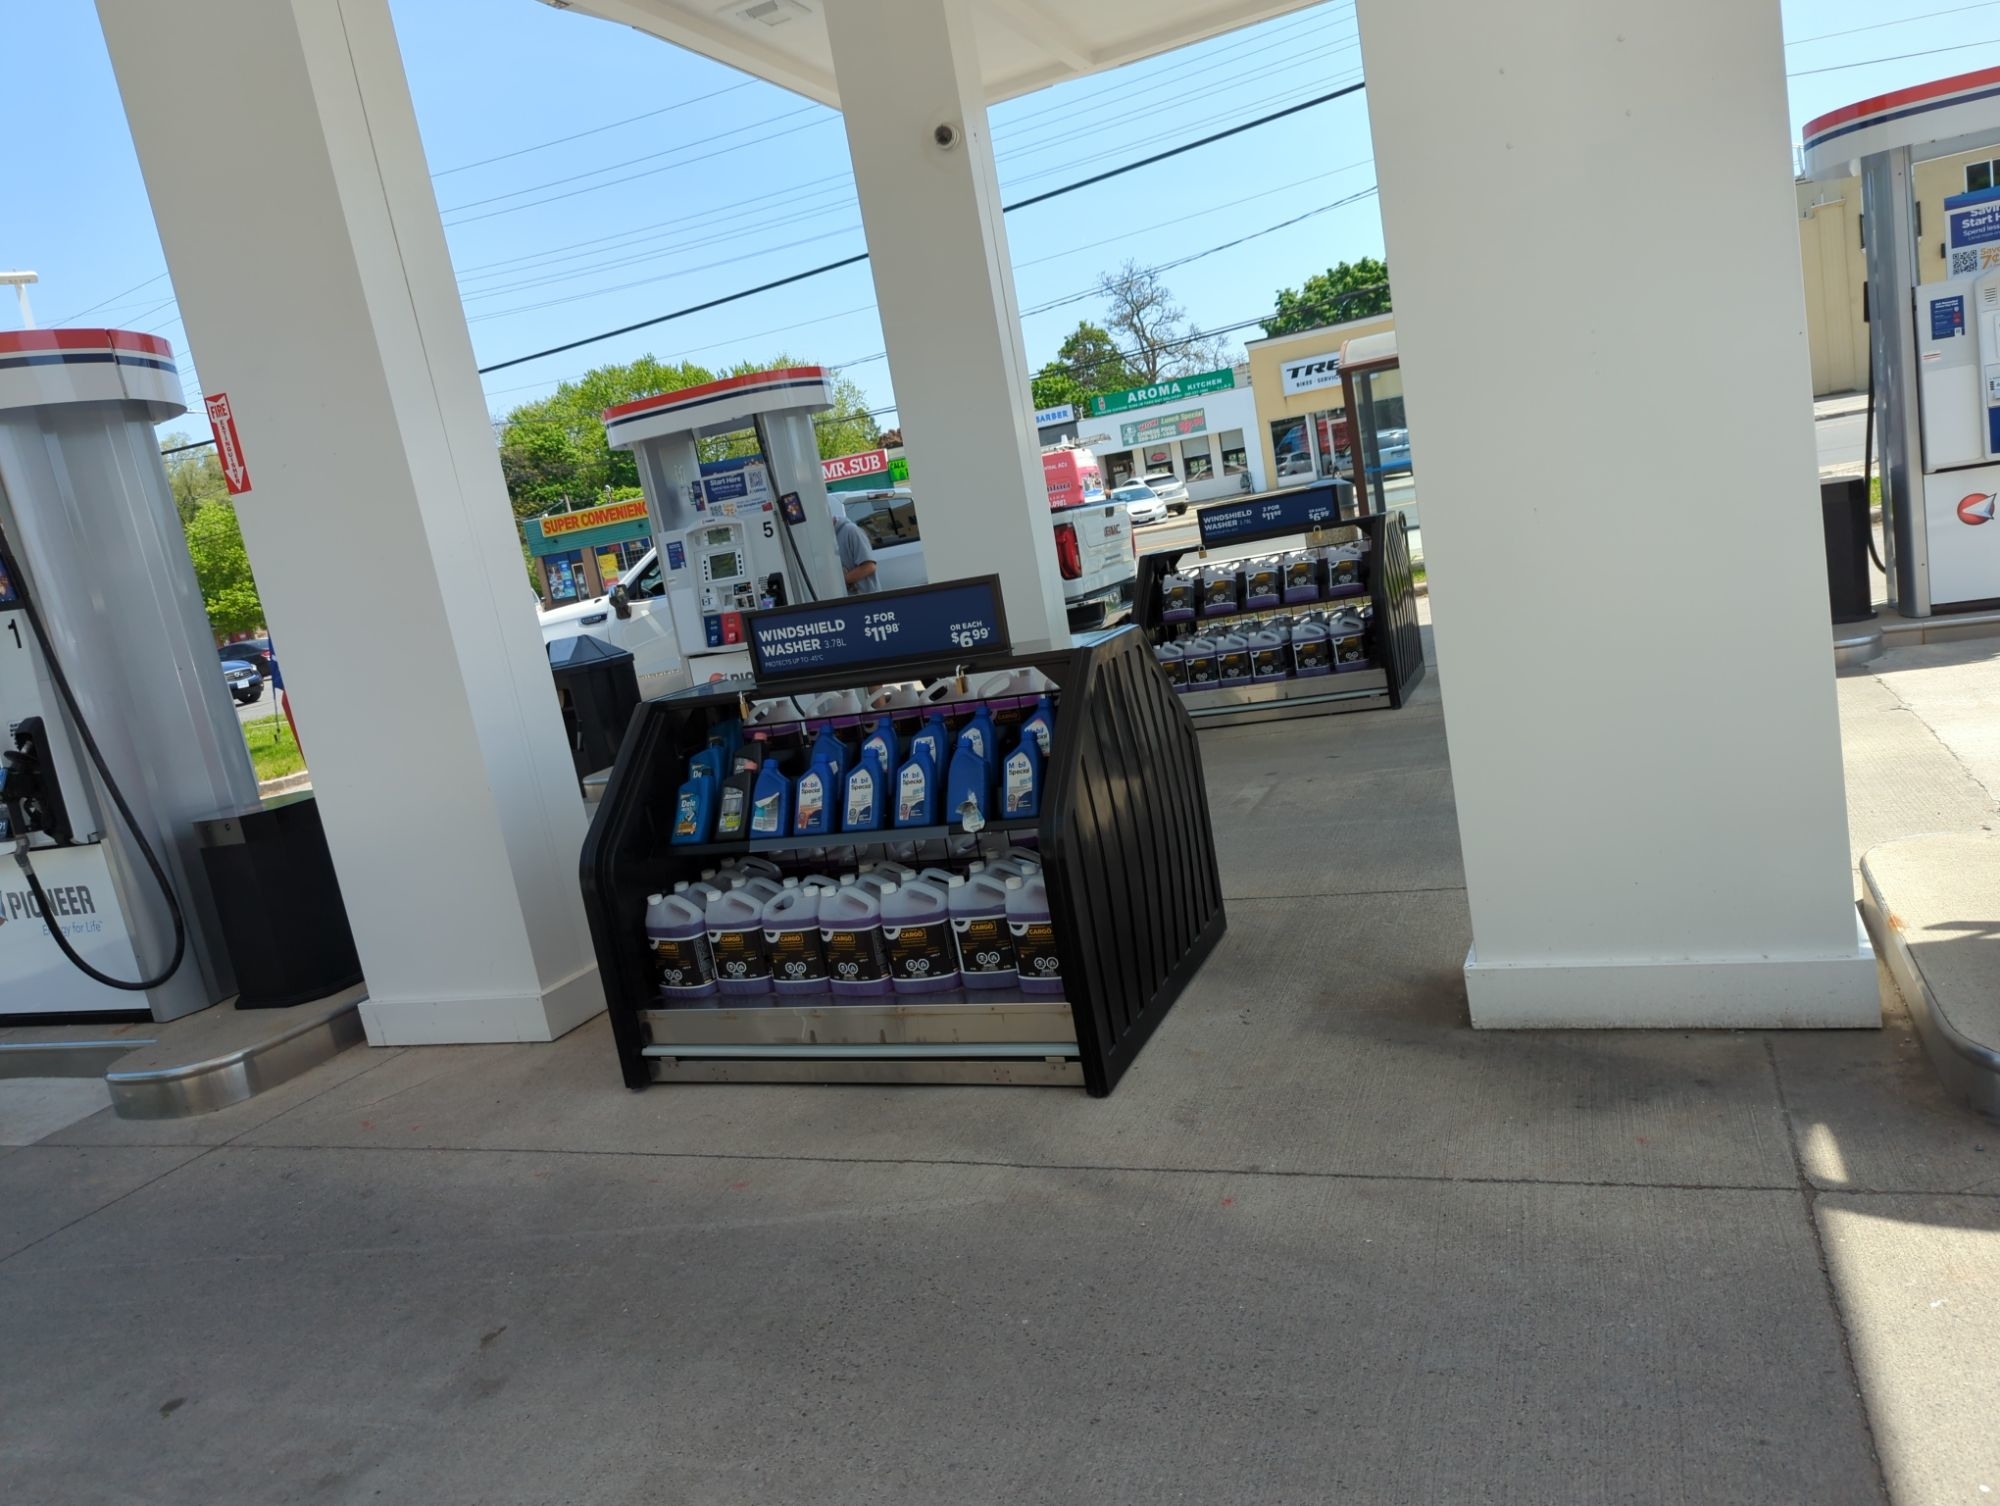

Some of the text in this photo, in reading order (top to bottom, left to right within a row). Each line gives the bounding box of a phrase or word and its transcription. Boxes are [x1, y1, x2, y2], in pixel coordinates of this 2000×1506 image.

[1962, 214, 1993, 229] Start
[1127, 382, 1181, 403] AROMA
[1187, 378, 1222, 391] KITCHEN
[210, 403, 228, 419] FIRE
[1203, 509, 1253, 524] WINDSHIELD
[543, 515, 580, 535] SUPER
[763, 521, 774, 538] 5
[1204, 519, 1238, 531] WASHER
[864, 611, 895, 624] 2 FOR
[962, 620, 982, 630] EACH
[8, 618, 22, 649] 1
[758, 619, 846, 643] WINDSHIELD
[761, 638, 847, 657] WASHER 3.78L
